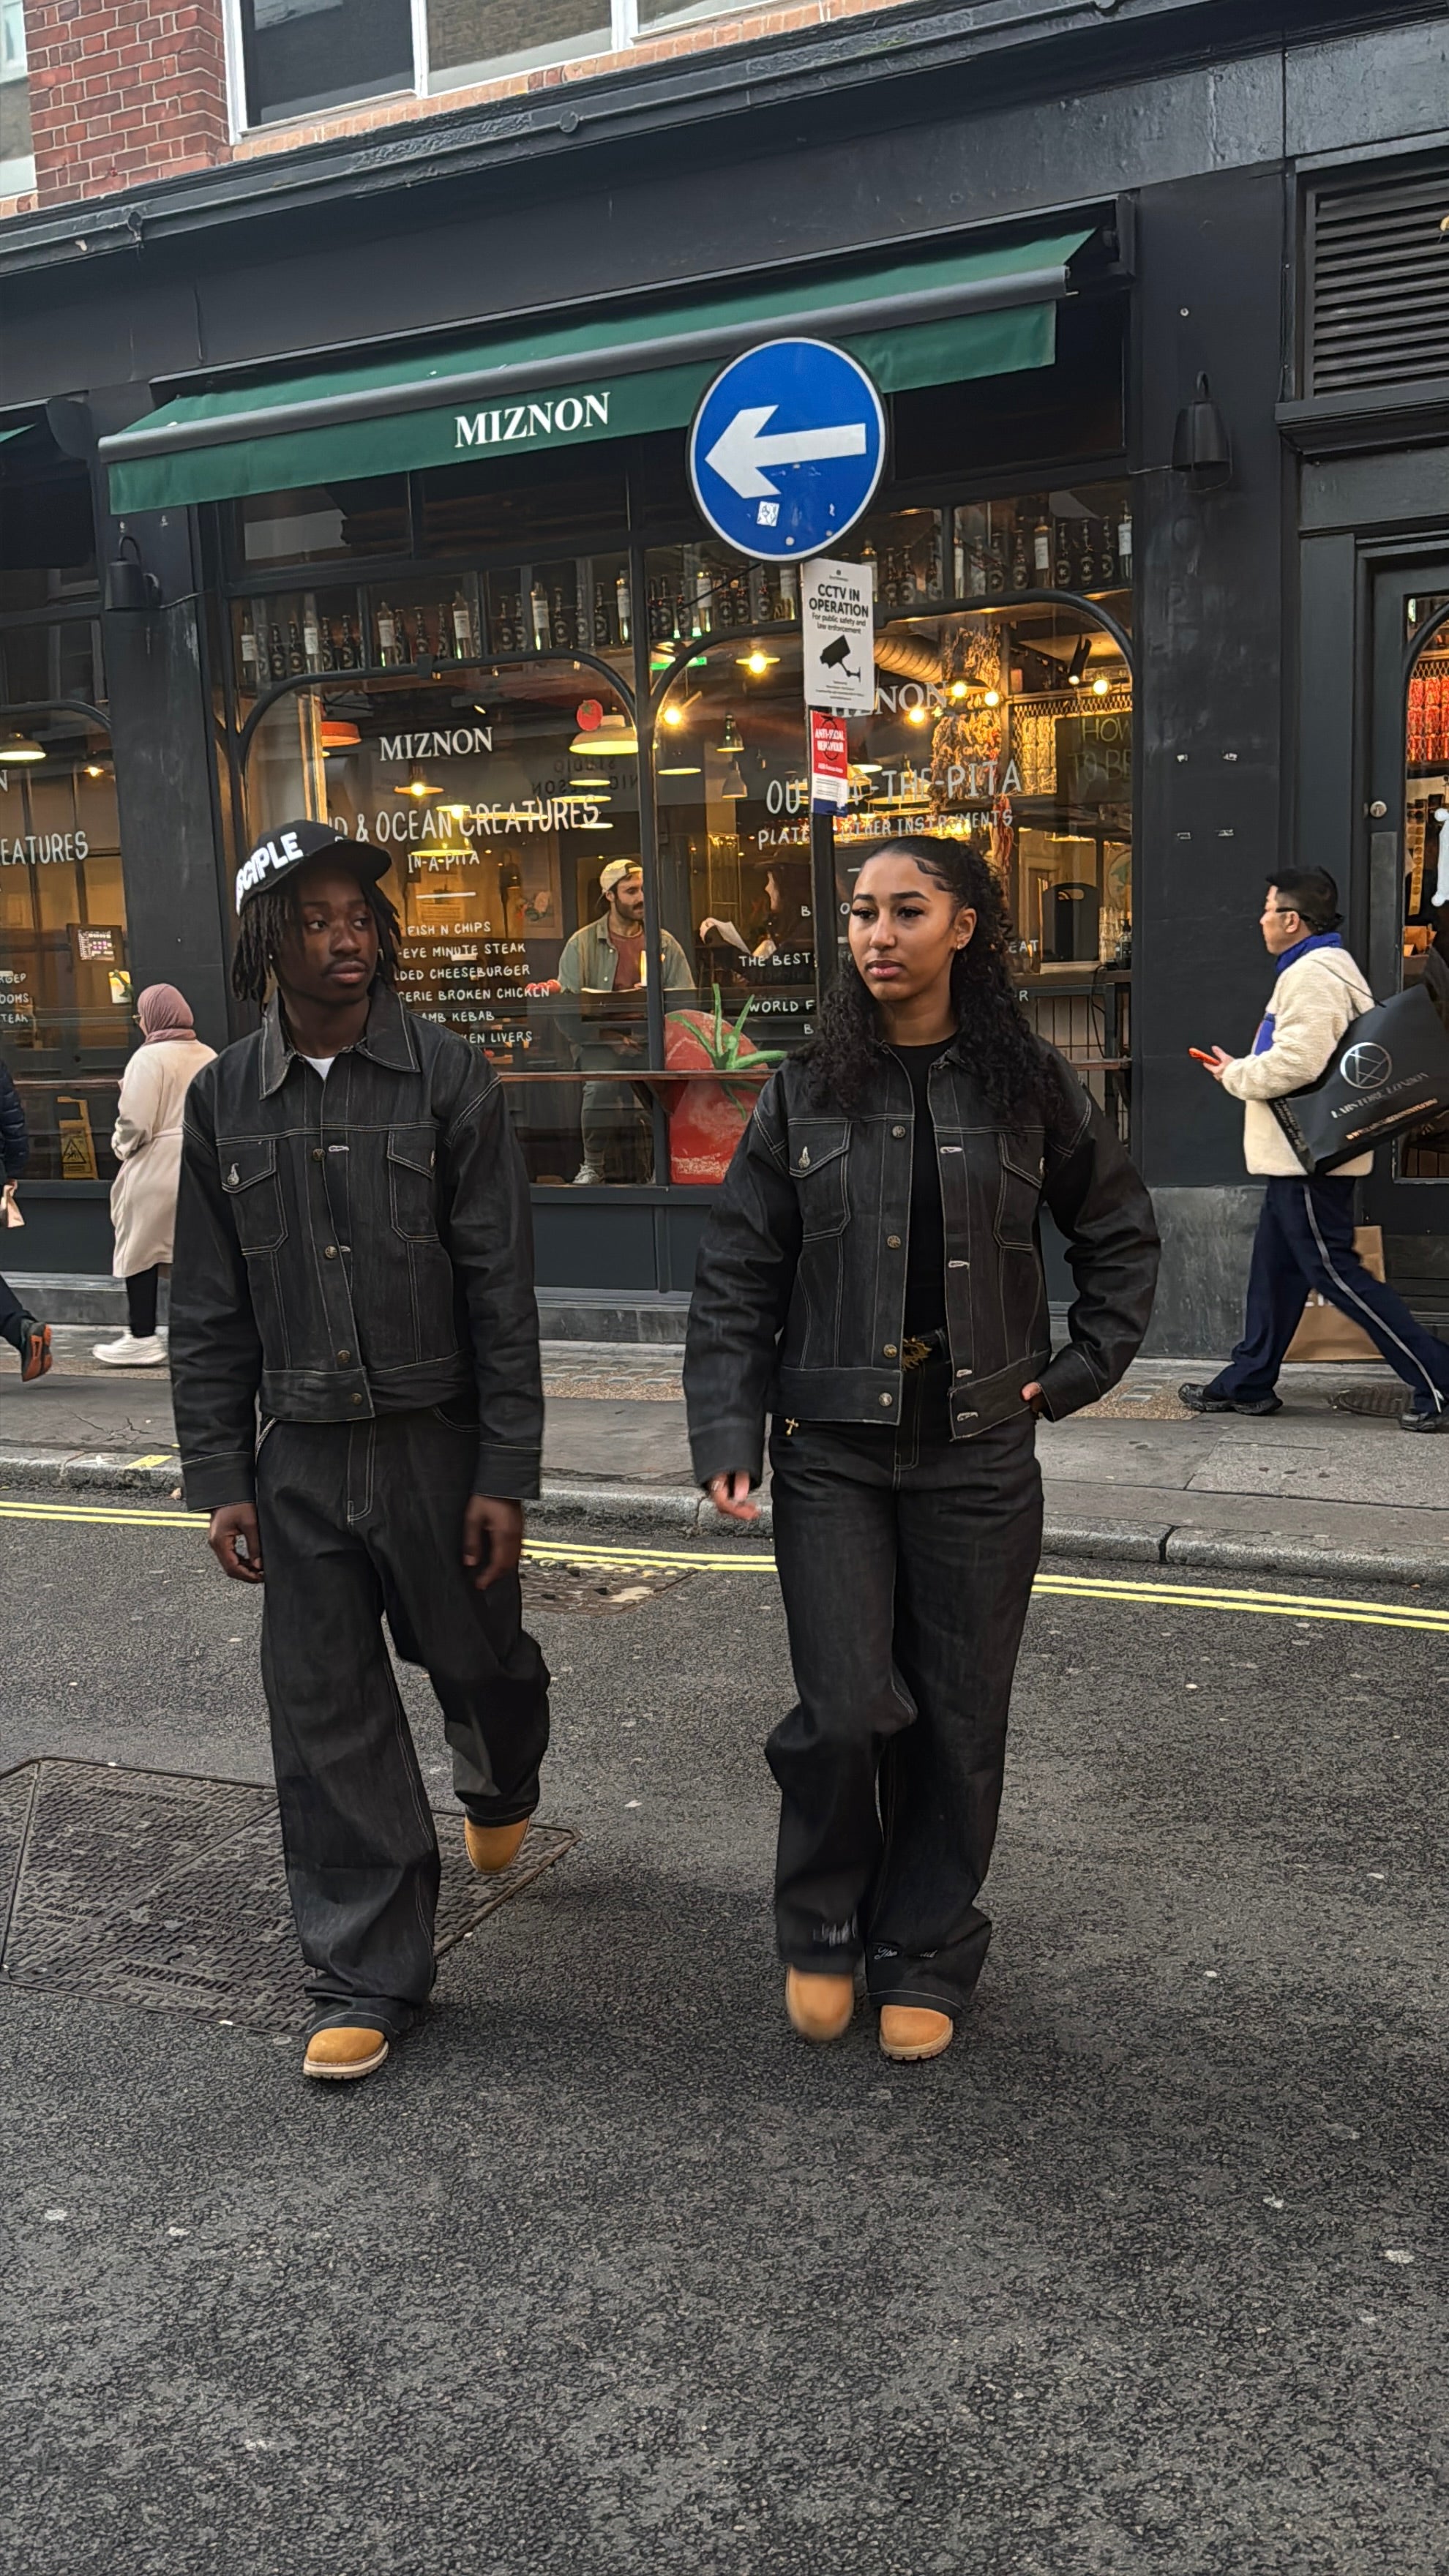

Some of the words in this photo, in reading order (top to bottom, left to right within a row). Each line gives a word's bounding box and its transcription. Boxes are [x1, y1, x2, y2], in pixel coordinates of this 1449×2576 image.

[454, 392, 610, 447] MIZNON
[818, 584, 846, 599] CCTV
[849, 588, 860, 602] IN
[809, 597, 869, 618] OPERATION
[822, 615, 838, 623] public
[839, 618, 855, 626] safety
[828, 625, 861, 634] enforcement
[378, 727, 493, 761] MIZNON
[356, 814, 370, 842] &
[376, 806, 452, 842] OCEAN
[459, 794, 600, 837] CREATURES
[408, 924, 435, 936] FISH
[441, 924, 449, 935] N
[454, 921, 491, 934] CHIPS
[433, 944, 478, 957] MINUTE
[484, 943, 526, 955] STEAK
[738, 955, 765, 967] THE
[773, 953, 811, 965] BEST
[430, 964, 531, 979] CHEESEBURGER
[438, 988, 491, 1000] BROKEN
[497, 986, 549, 998] CHICKEN
[749, 1000, 799, 1013] WORLD
[452, 1010, 495, 1022] KEBAB
[491, 1030, 533, 1043] LIVERS
